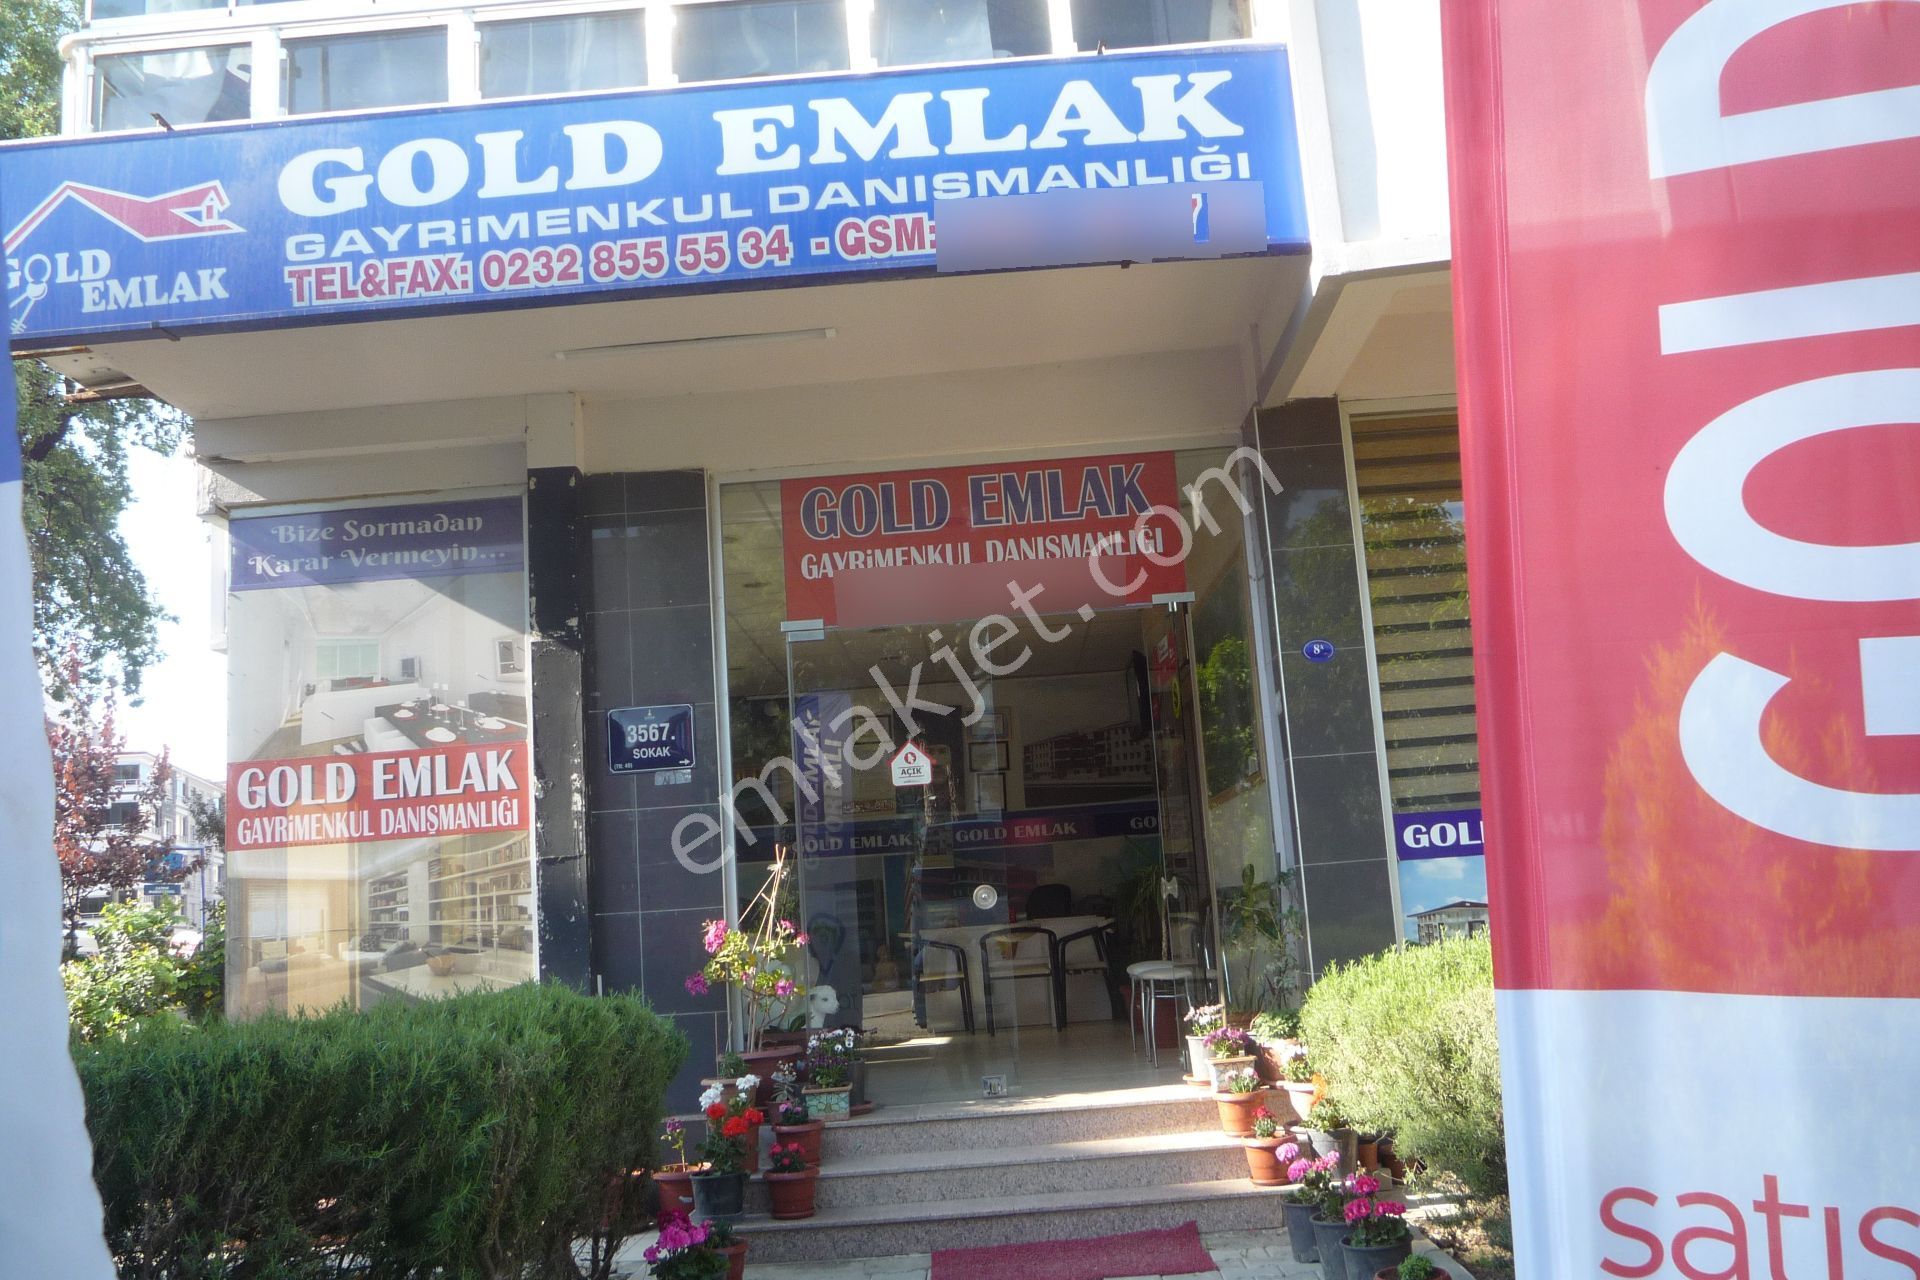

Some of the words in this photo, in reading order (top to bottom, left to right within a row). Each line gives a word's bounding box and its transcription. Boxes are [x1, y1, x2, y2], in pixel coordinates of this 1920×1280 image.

[277, 120, 664, 217] GOLD
[713, 70, 1244, 177] EMLAK
[285, 254, 473, 306] TEL&FAX:
[481, 244, 583, 291] 0232
[589, 236, 668, 283] 855
[676, 231, 730, 275] 55
[738, 224, 793, 268] 34
[81, 268, 229, 313] EMLAK
[801, 479, 950, 540] GOLD
[968, 463, 1154, 528] EMLAK
[272, 524, 335, 544] Bize
[343, 514, 483, 542] Sormadan
[248, 554, 333, 577] Karar
[627, 722, 676, 743] 3567.
[633, 746, 671, 759] SOKAK
[237, 762, 356, 810] GOLD
[373, 749, 518, 800] EMLAK
[901, 767, 923, 778] AÇIK
[851, 833, 913, 849] EMLAK
[955, 826, 1007, 843] GOLD
[1014, 821, 1077, 839] EMLAK
[1403, 820, 1485, 848] GOL
